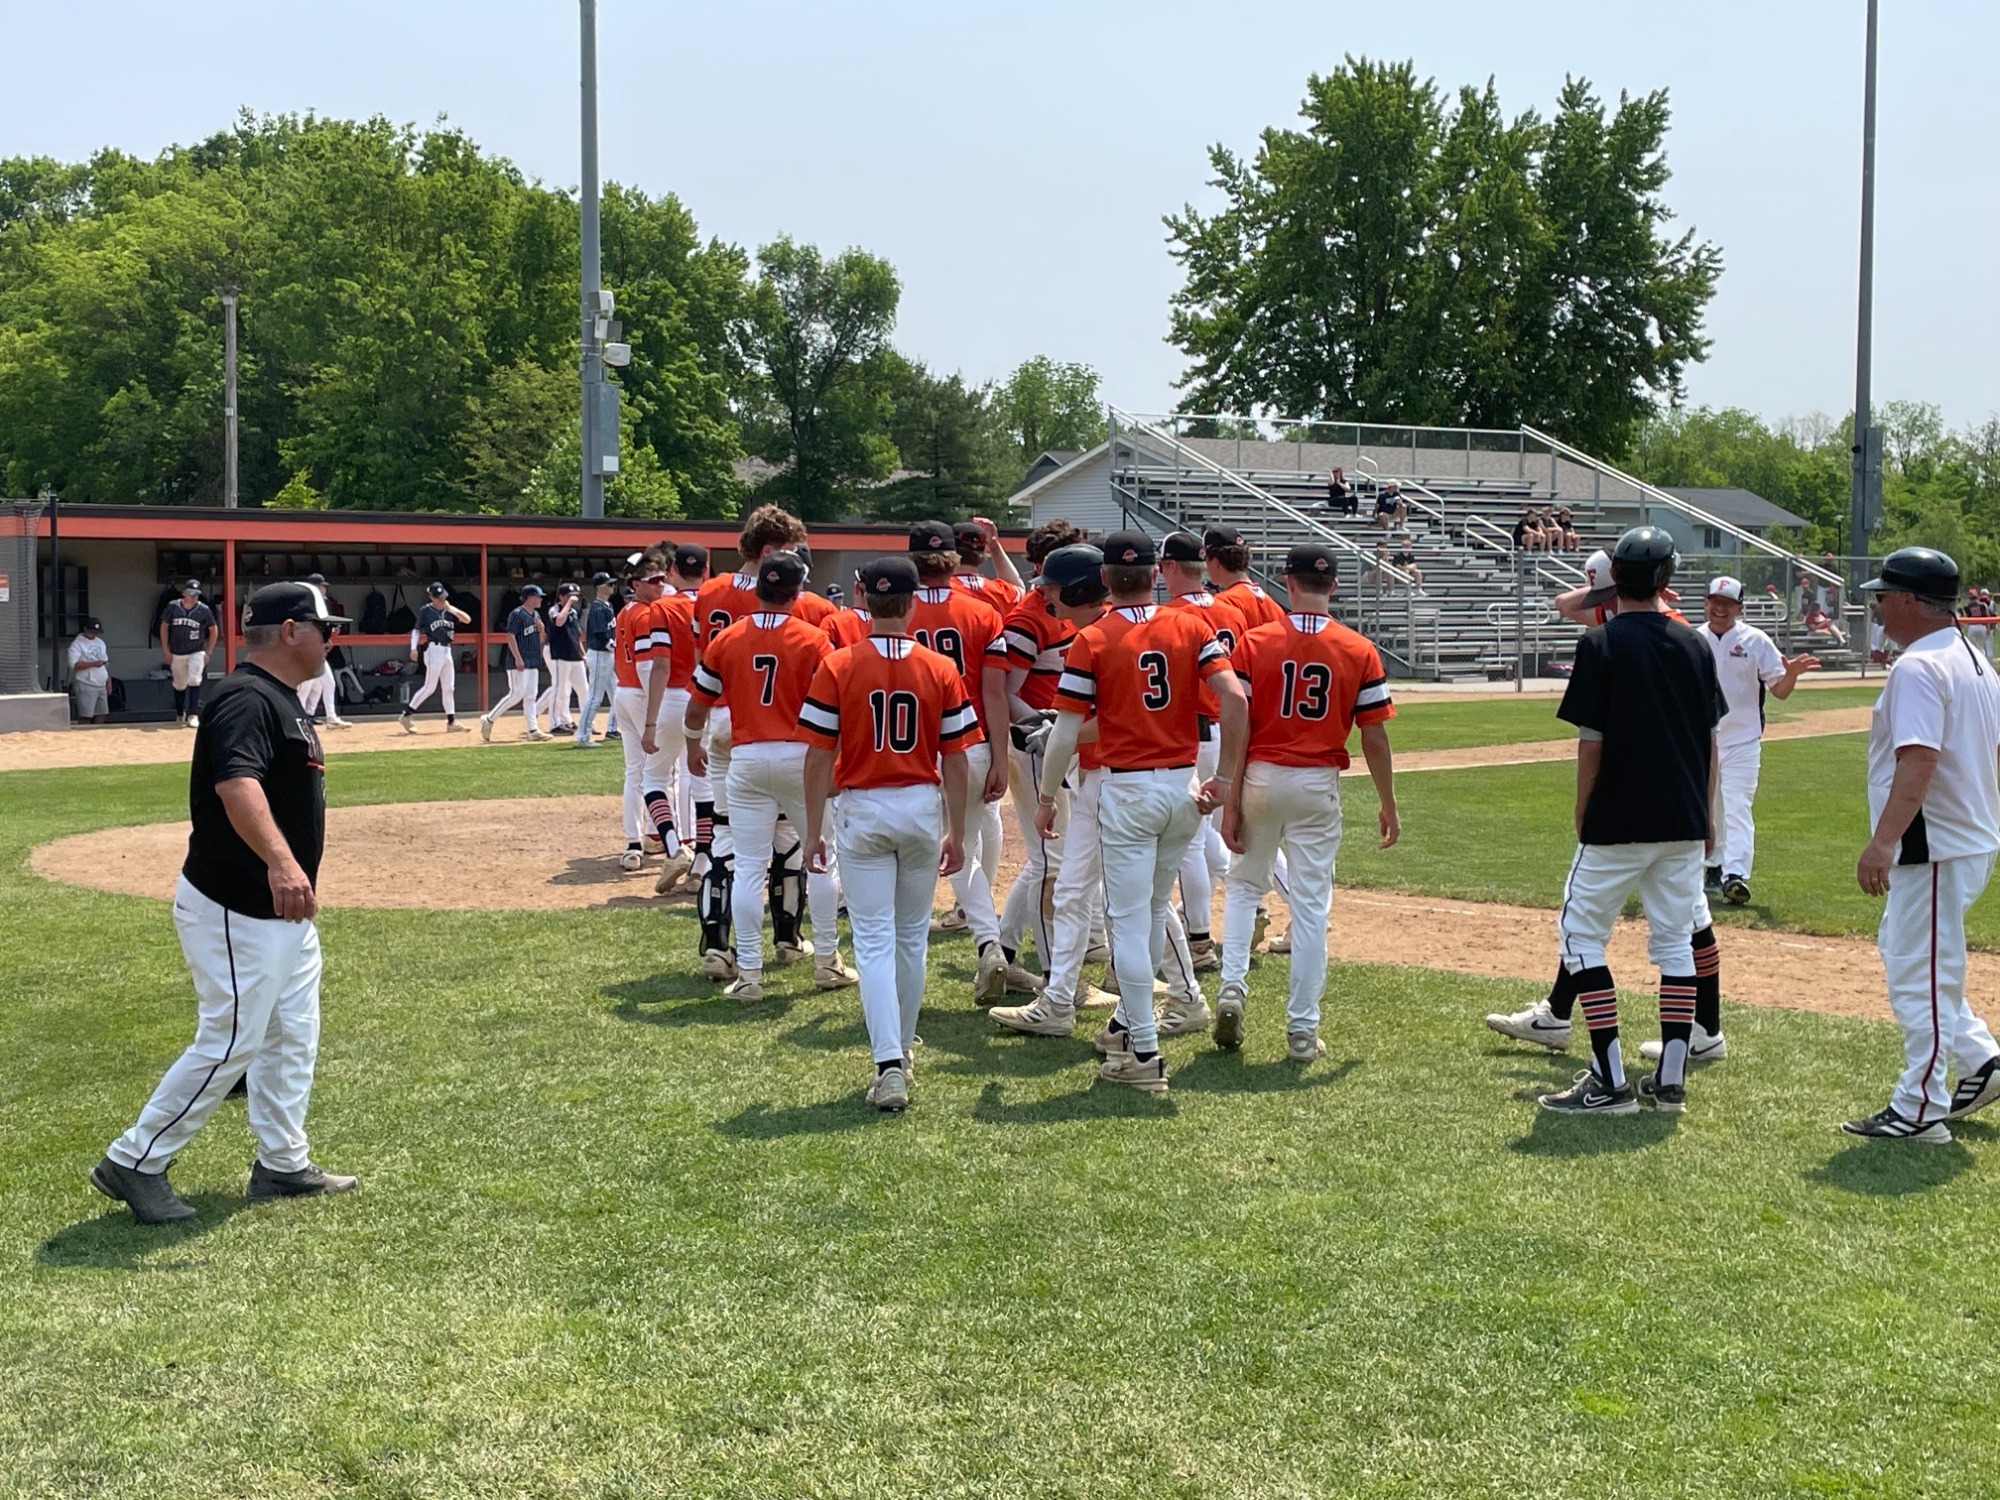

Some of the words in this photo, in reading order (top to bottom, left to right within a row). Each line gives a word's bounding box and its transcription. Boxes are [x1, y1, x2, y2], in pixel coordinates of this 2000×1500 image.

[1718, 579, 1731, 591] F
[753, 654, 779, 706] 7
[1138, 650, 1171, 711] 3
[1280, 660, 1332, 721] 13
[869, 689, 919, 753] 10
